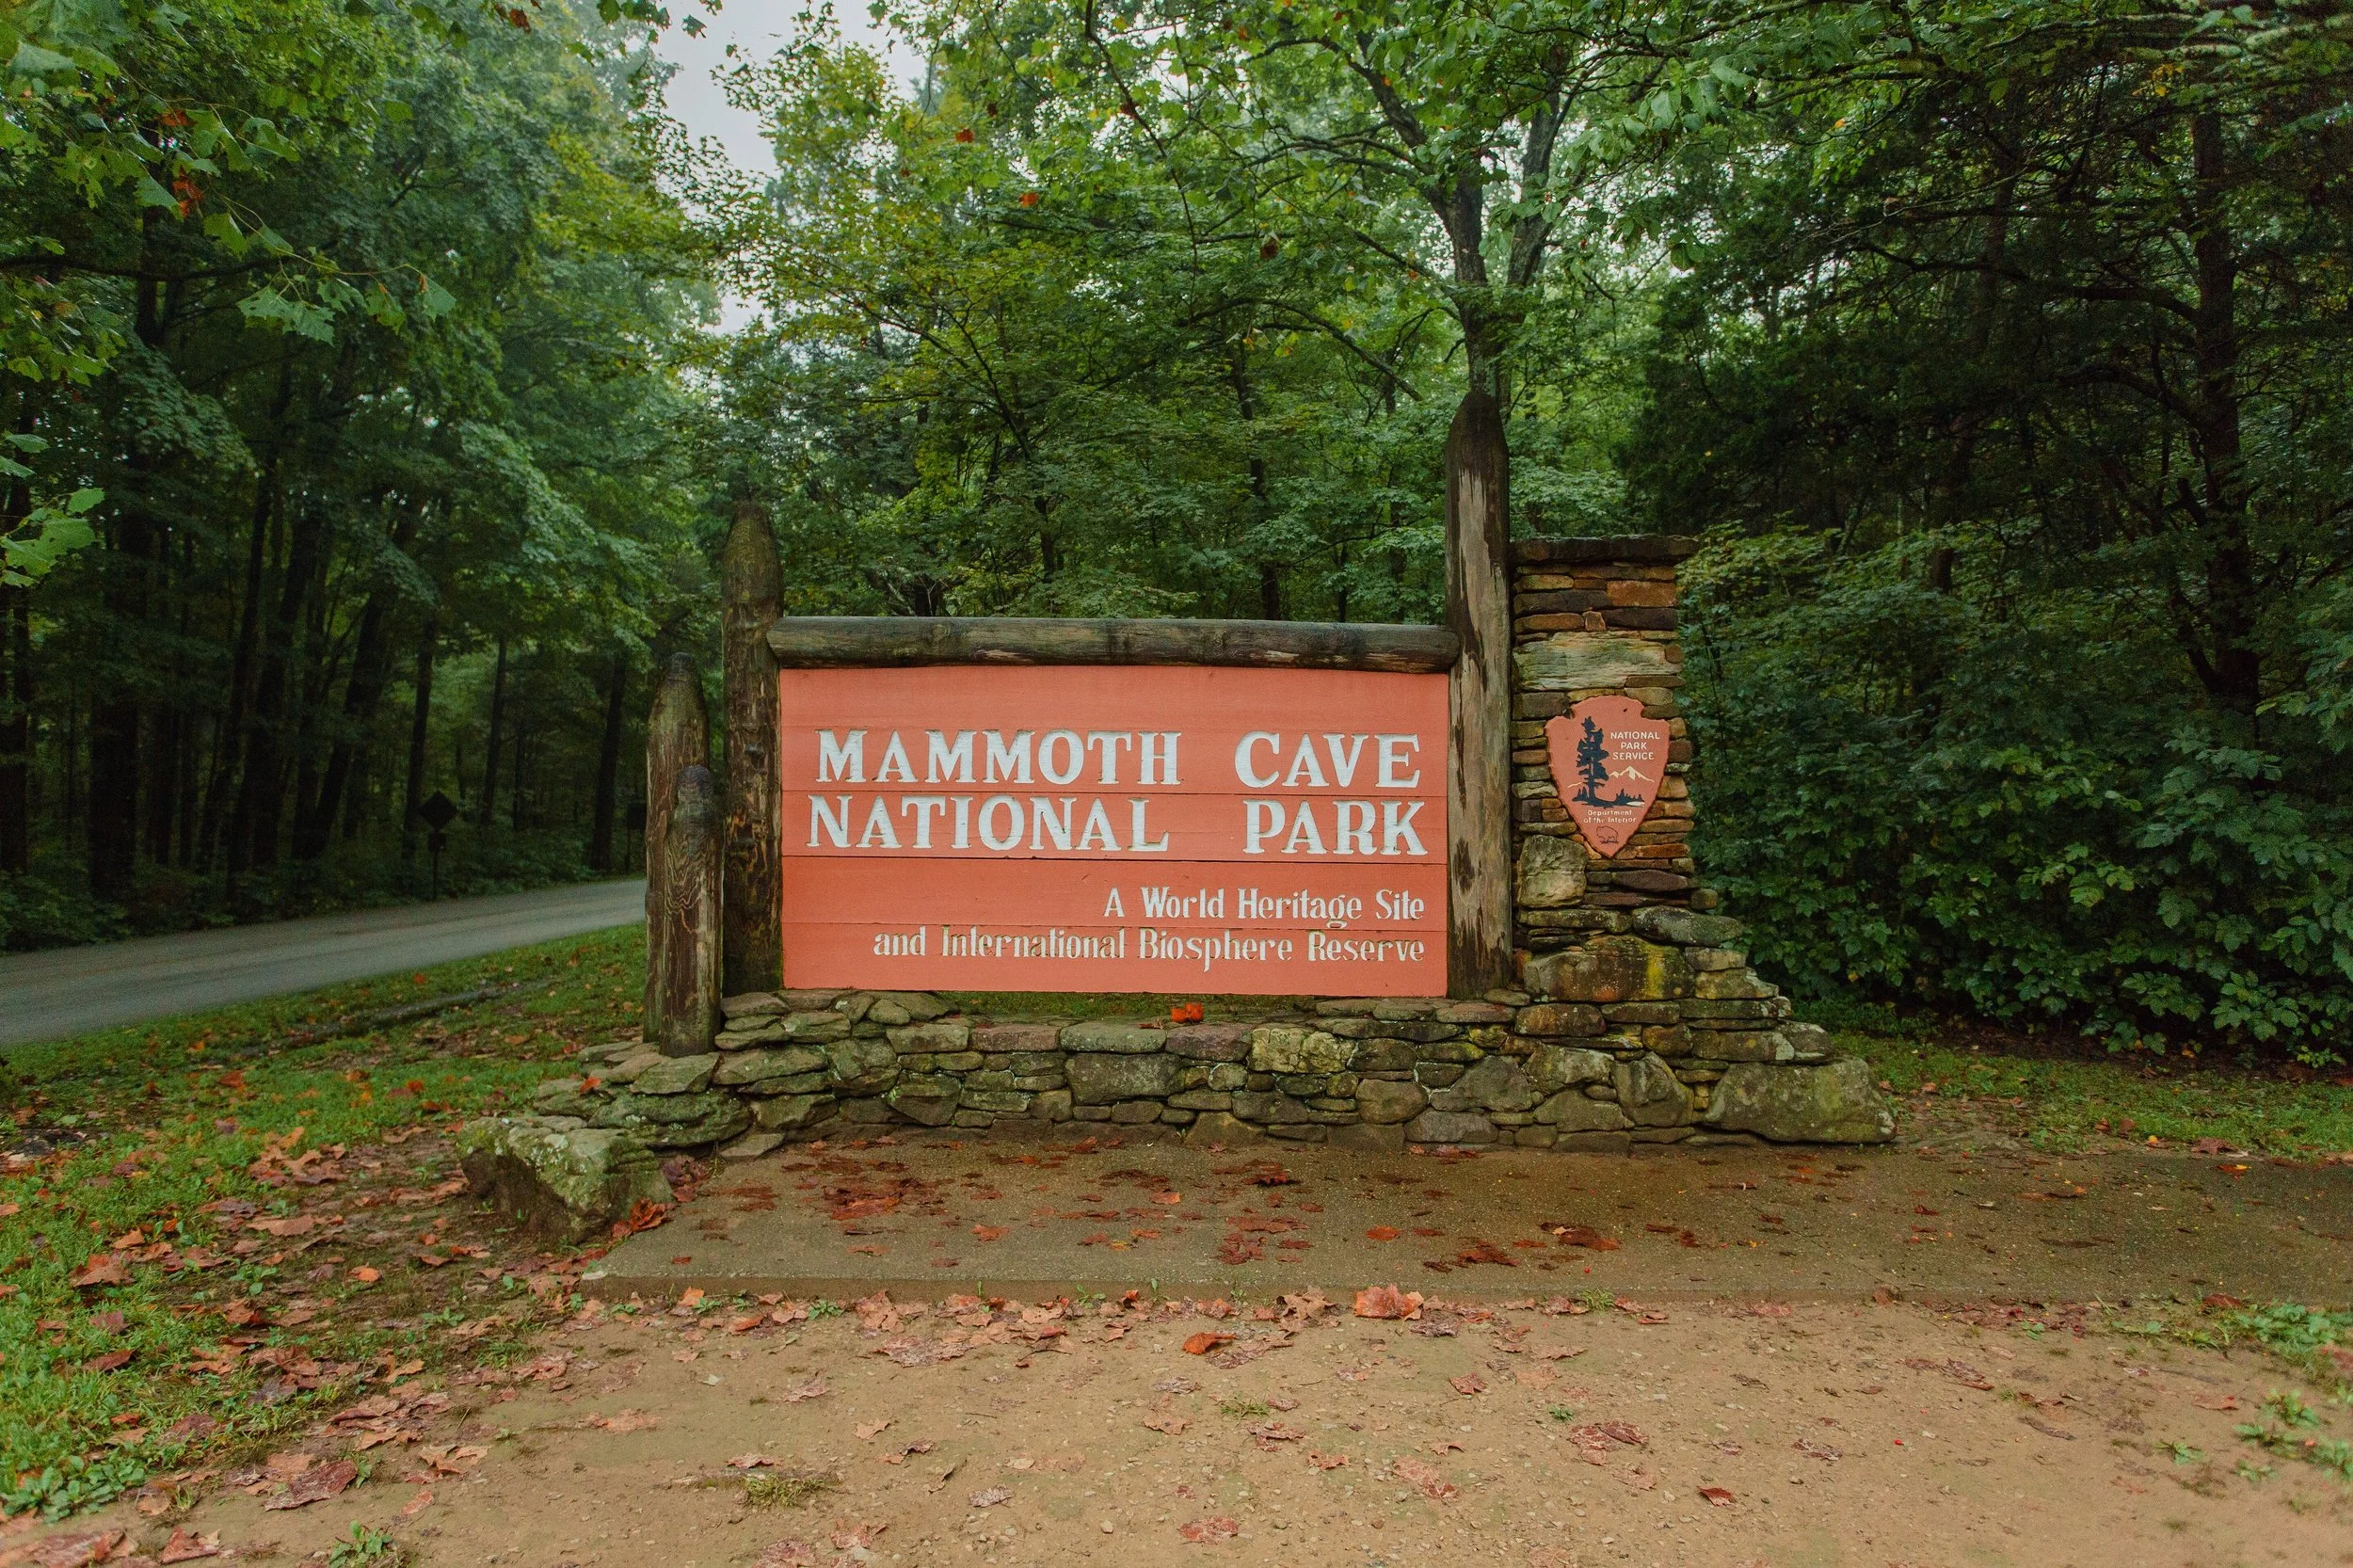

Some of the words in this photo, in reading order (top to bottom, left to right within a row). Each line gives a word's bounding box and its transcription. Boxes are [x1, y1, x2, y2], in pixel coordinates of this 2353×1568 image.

[1610, 731, 1660, 740] NATIONAL
[1612, 752, 1655, 760] SERVICE
[1620, 742, 1647, 750] PARK
[814, 728, 1181, 786] MAMMOTH
[1235, 731, 1420, 789] CAVE
[806, 794, 1169, 852] NATIONAL
[1243, 799, 1428, 856] PARK
[1104, 888, 1125, 918] A
[1141, 887, 1225, 920] World
[1238, 888, 1362, 928] Heritage
[1375, 888, 1424, 920] Site
[873, 926, 926, 958] and
[941, 925, 1125, 959] International
[1139, 928, 1293, 972] Biosphere
[1308, 931, 1424, 962] Reserve
